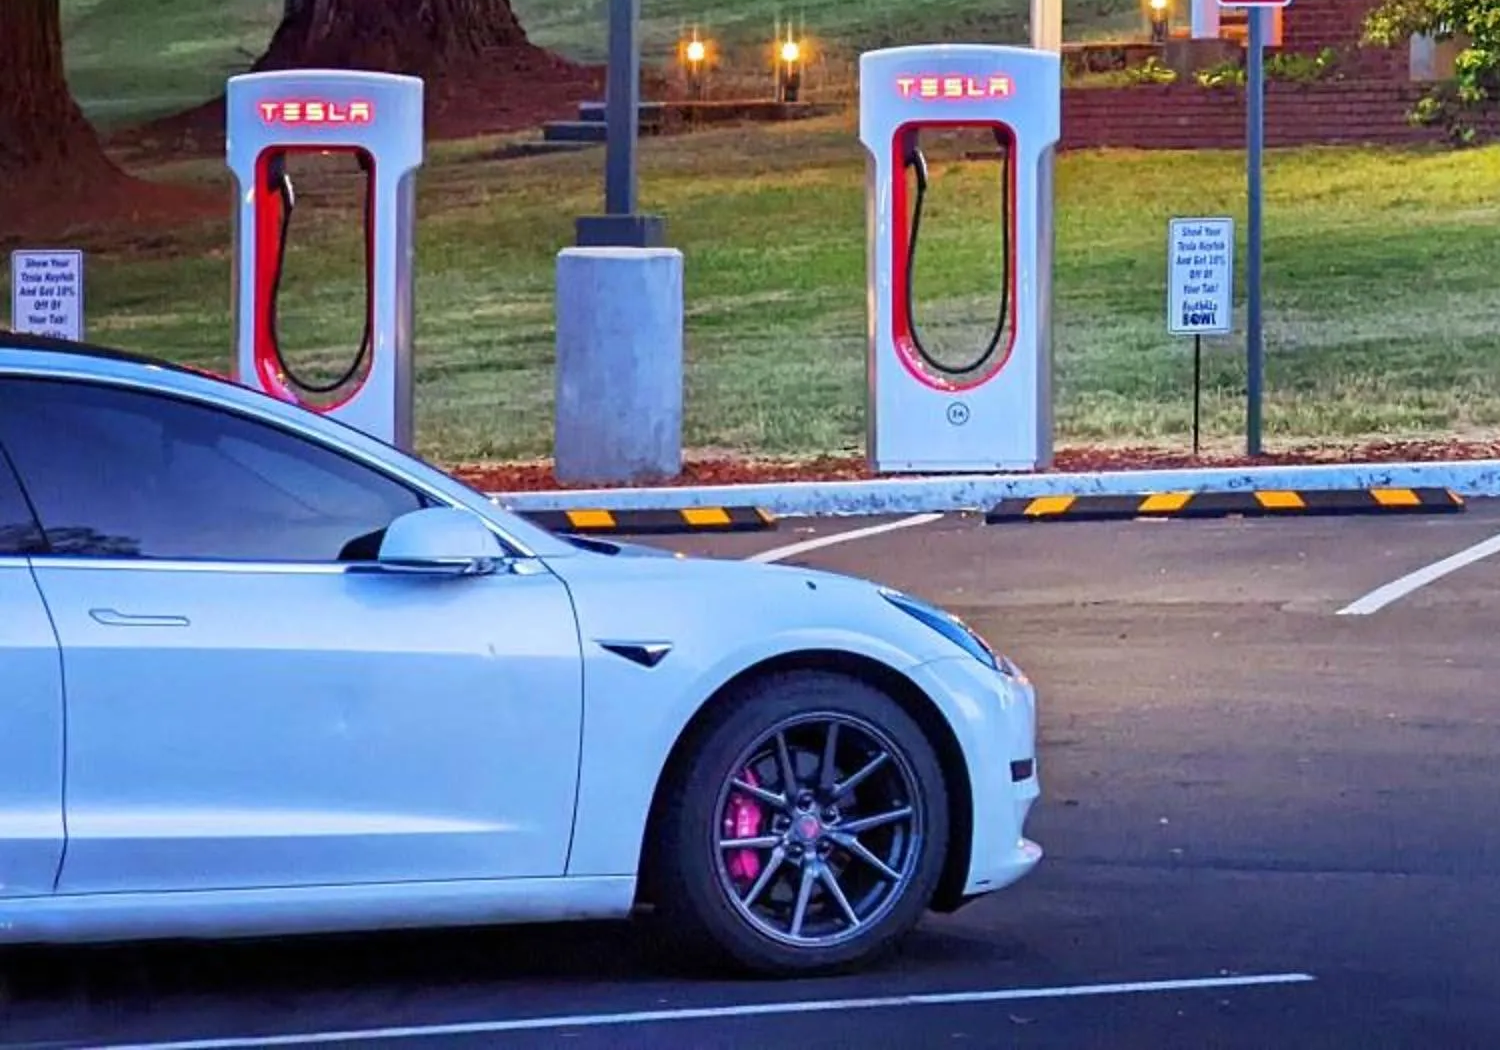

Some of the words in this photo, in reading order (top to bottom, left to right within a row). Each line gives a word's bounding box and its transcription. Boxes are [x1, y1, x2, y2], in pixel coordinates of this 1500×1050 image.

[896, 78, 1010, 97] TESLA
[260, 103, 370, 122] TESLA
[1183, 313, 1217, 326] BOWL
